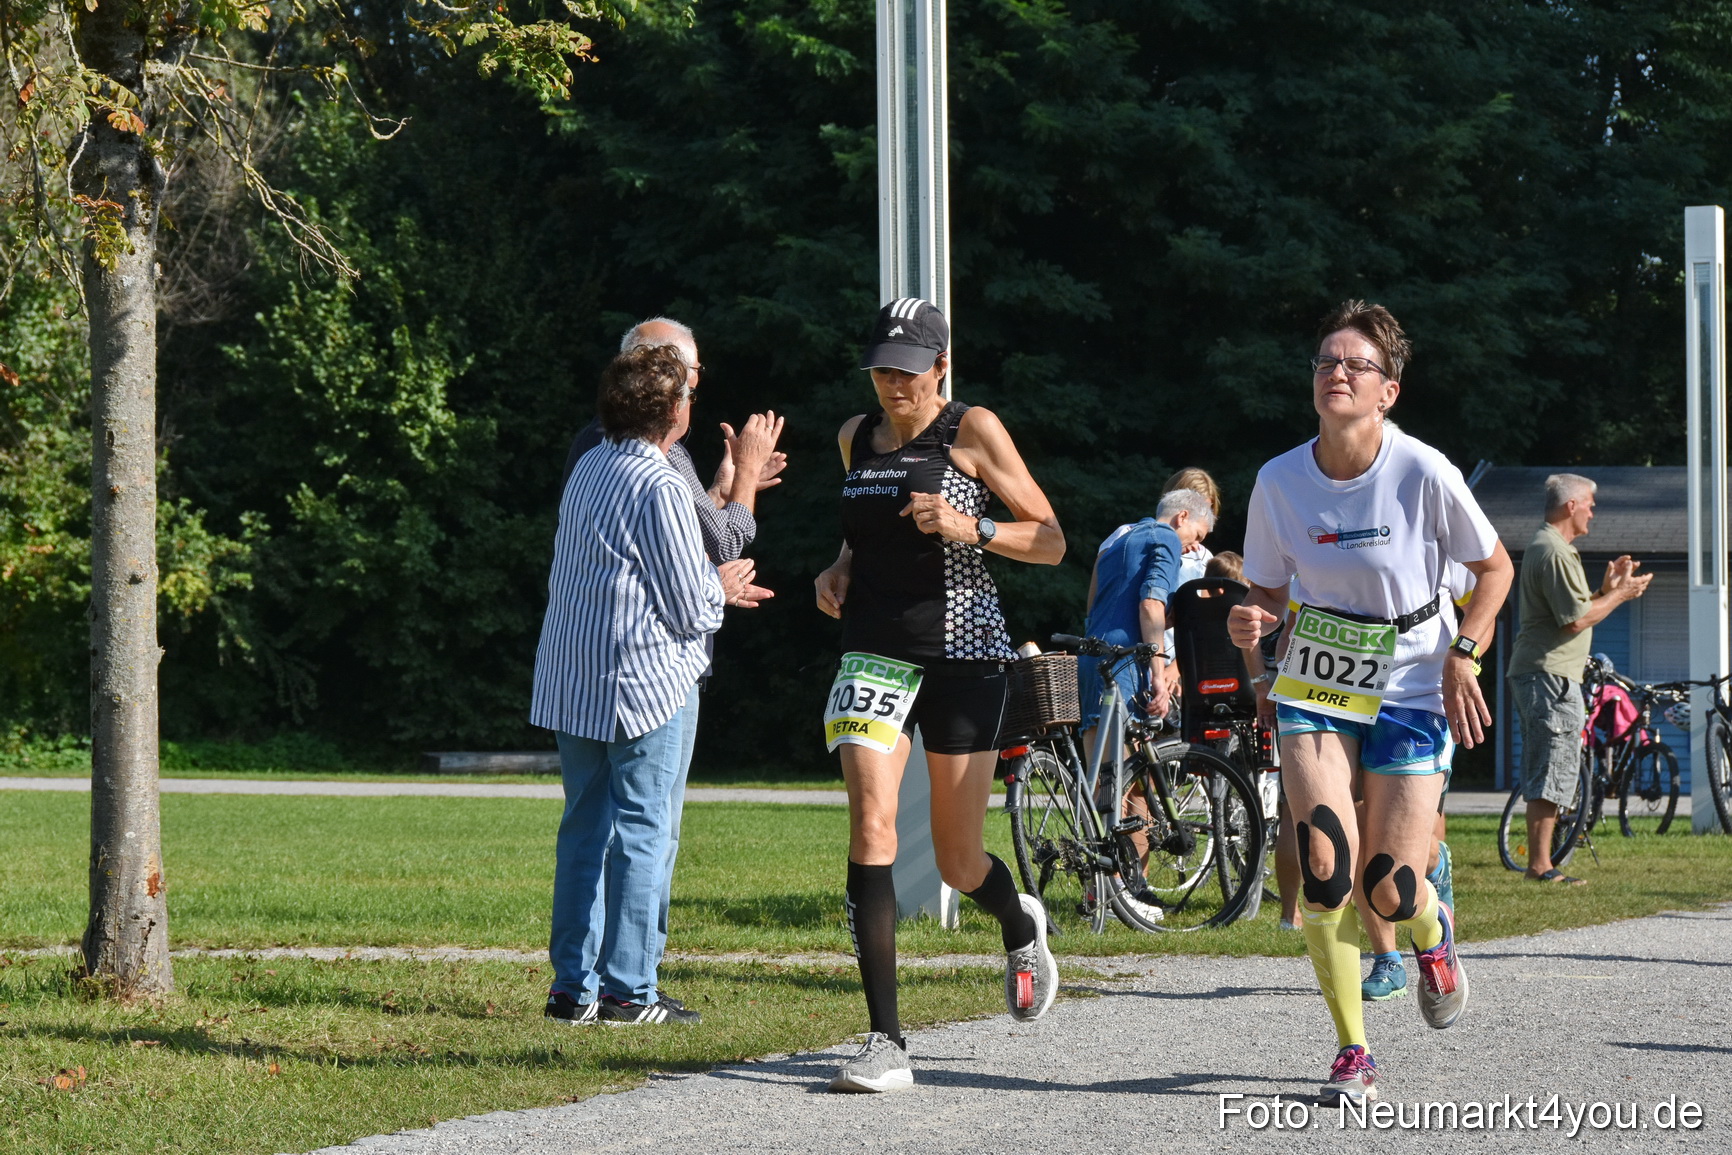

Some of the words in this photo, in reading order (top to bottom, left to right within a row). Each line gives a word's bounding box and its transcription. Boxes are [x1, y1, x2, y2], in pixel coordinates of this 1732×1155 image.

[860, 469, 907, 480] Marathon
[842, 484, 899, 498] Regensburg
[1346, 538, 1391, 550] Landkreislauf
[1300, 612, 1386, 651] BOCK
[1300, 646, 1378, 690] 1022
[832, 684, 900, 717] 1035
[1306, 689, 1350, 708] LORE
[833, 721, 869, 735] PETRA
